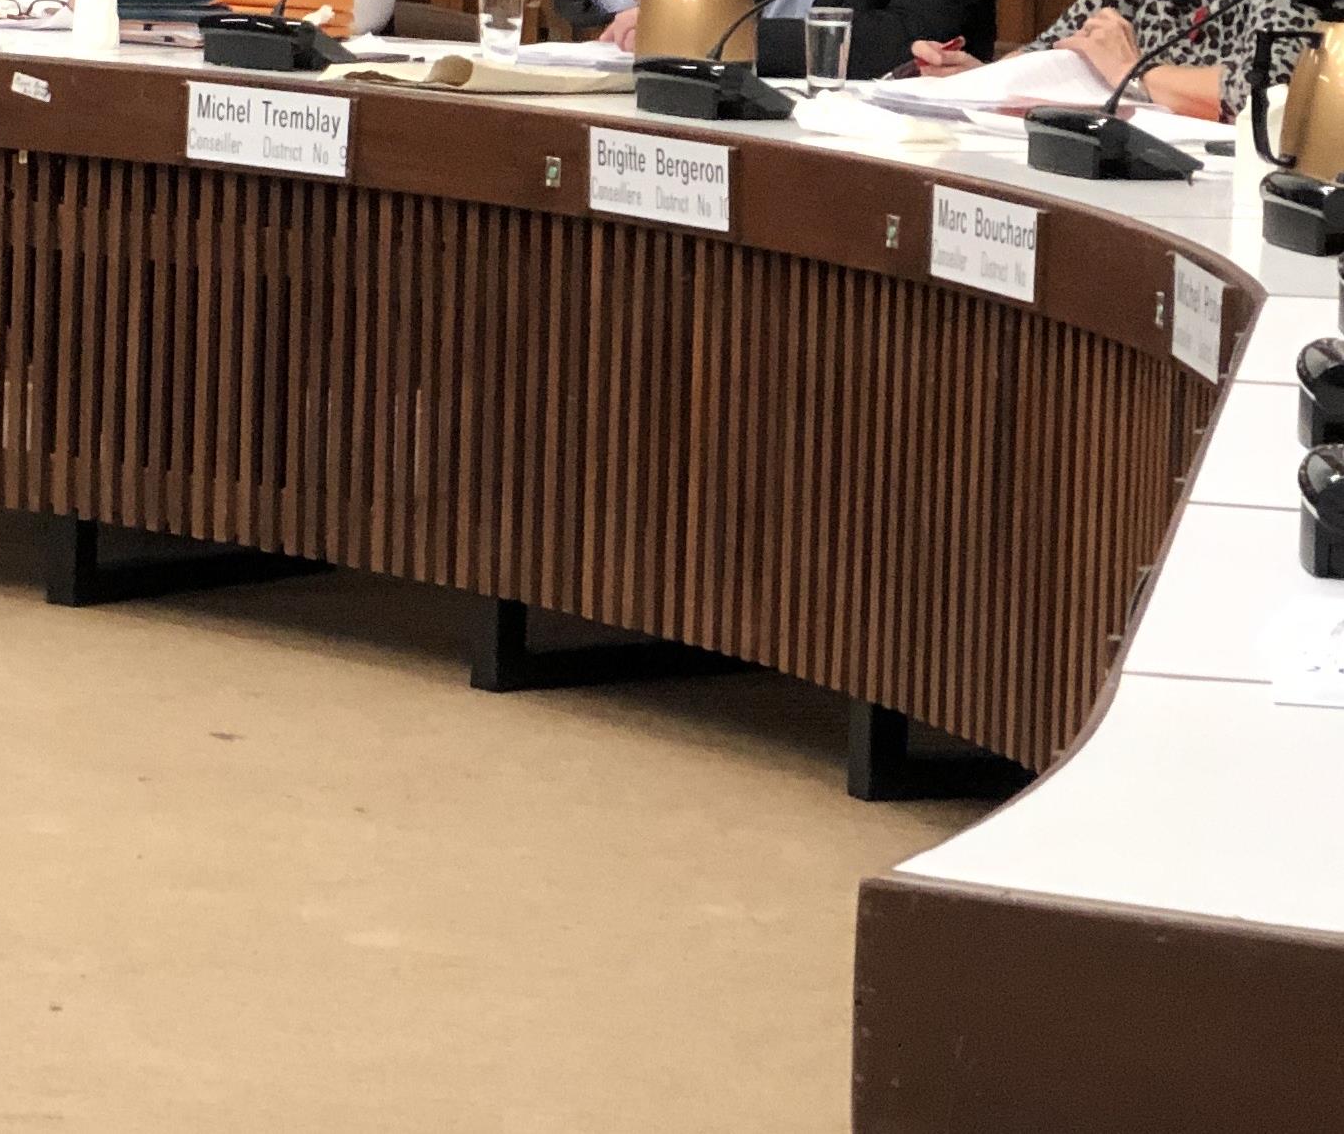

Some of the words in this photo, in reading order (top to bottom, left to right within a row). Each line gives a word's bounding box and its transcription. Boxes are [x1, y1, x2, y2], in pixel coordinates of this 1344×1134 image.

[197, 92, 251, 124] Michel
[262, 100, 341, 139] Tremblay
[188, 128, 243, 154] Conseiller
[263, 136, 302, 162] District
[313, 142, 329, 165] No
[339, 145, 347, 167] 9
[597, 139, 646, 175] Brigitte
[656, 147, 724, 185] Bergeron
[938, 198, 967, 234] Marc
[975, 207, 1036, 251] Bouchard
